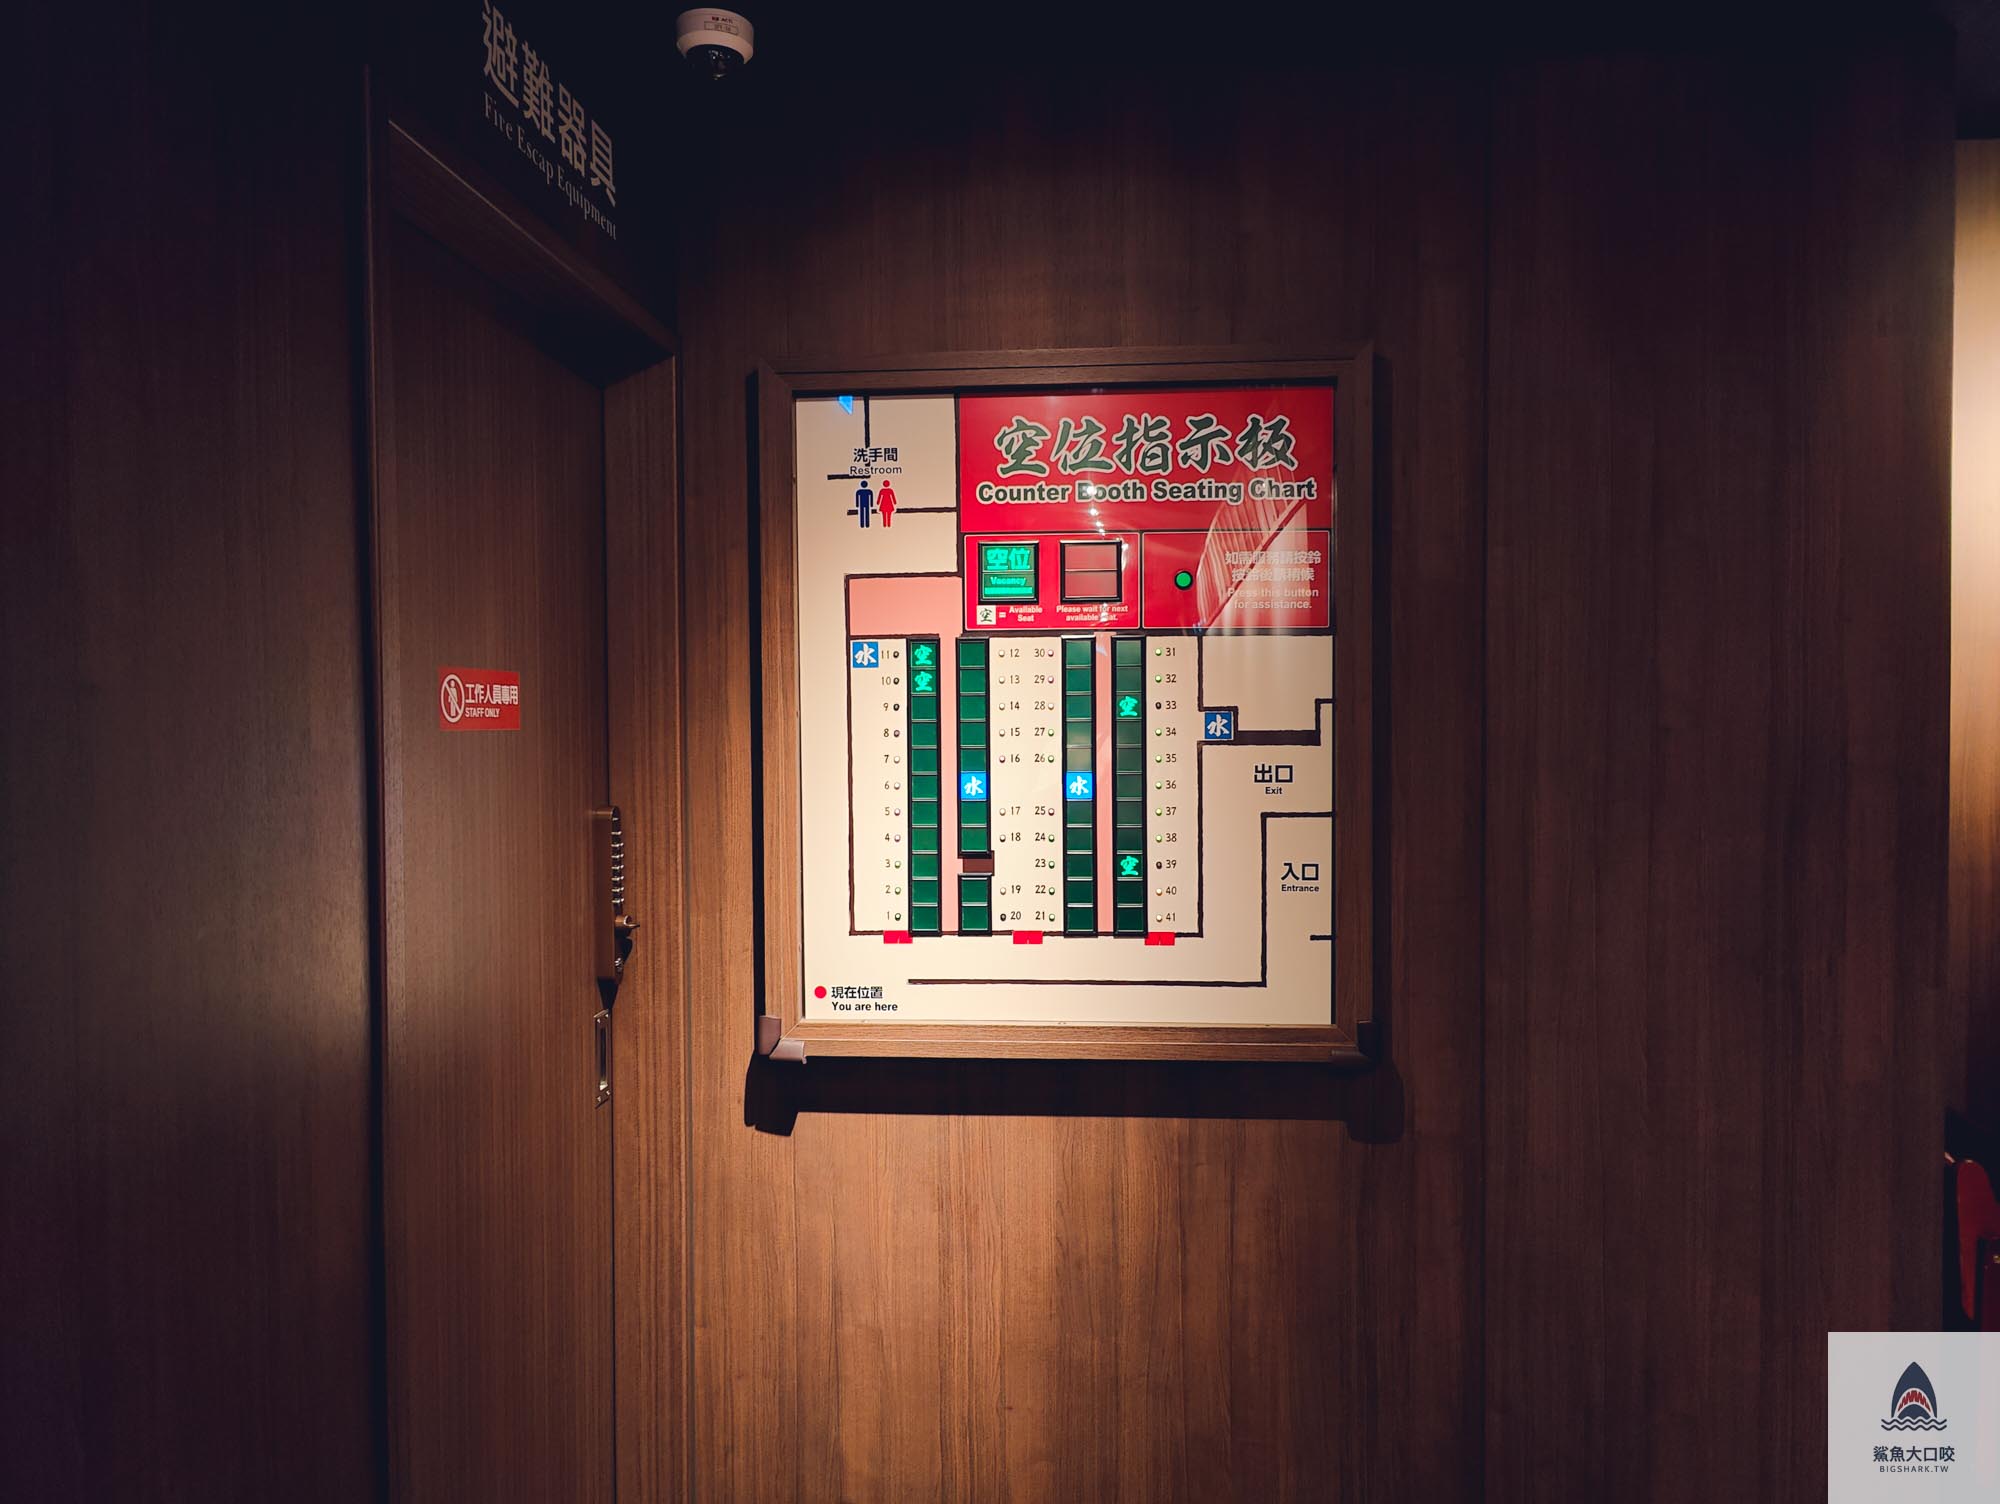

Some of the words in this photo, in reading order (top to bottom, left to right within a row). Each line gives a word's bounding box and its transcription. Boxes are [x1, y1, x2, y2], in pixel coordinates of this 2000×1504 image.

[482, 0, 615, 207] 避難器具
[484, 92, 513, 140] Fire
[518, 125, 554, 185] Escap
[557, 164, 616, 240] Equipment
[994, 413, 1298, 478] 空位指示板
[853, 448, 898, 463] 洗手間
[850, 466, 902, 475] Restroom
[976, 480, 1070, 503] Counter
[1077, 480, 1146, 503] Booth
[1153, 479, 1243, 504] Seating
[1250, 477, 1316, 501] Chart
[986, 547, 1031, 571] 空位
[990, 576, 1026, 586] Vacancy
[1227, 588, 1257, 597] Press
[1262, 588, 1280, 597] this
[1285, 588, 1319, 597] button
[1009, 606, 1043, 614] Available
[1056, 605, 1081, 613] Please
[1082, 605, 1098, 613] wait
[1111, 605, 1128, 613] next
[1234, 600, 1248, 609] for
[1253, 600, 1313, 609] assistance.
[980, 607, 993, 622] 空
[1017, 614, 1034, 622] Seat
[854, 643, 877, 666] 水
[881, 649, 889, 660] 11
[914, 644, 933, 666] 空
[1009, 648, 1020, 658] 12
[1034, 647, 1046, 658] 30
[1165, 646, 1175, 657] 31
[881, 675, 891, 686] 10
[914, 671, 933, 692] 空
[1010, 674, 1020, 685] 13
[1033, 674, 1046, 684] 29
[1165, 673, 1176, 684] 32
[465, 683, 519, 705] 工作人員專用
[882, 702, 888, 712] 9
[1009, 700, 1020, 711] 14
[1034, 700, 1046, 711] 28
[1119, 695, 1138, 717] 空
[1165, 700, 1176, 710] 33
[465, 707, 484, 718] STAFF
[484, 708, 500, 718] ONLY
[1207, 714, 1230, 737] 水
[883, 727, 889, 738] 8
[1010, 726, 1020, 737] 15
[1034, 726, 1046, 737] 27
[1165, 726, 1176, 737] 34
[883, 753, 889, 764] 7
[1010, 753, 1020, 764] 16
[1033, 753, 1046, 763] 26
[1165, 753, 1176, 763] 35
[1254, 763, 1293, 783] 出口
[884, 780, 889, 791] 6
[964, 776, 984, 797] 水
[1070, 776, 1089, 797] 水
[1165, 779, 1176, 790] 36
[1265, 786, 1283, 795] Exit
[884, 806, 890, 817] 5
[1010, 805, 1021, 816] 17
[1034, 805, 1046, 816] 25
[1165, 806, 1176, 816] 37
[884, 832, 890, 843] 4
[1010, 831, 1021, 842] 18
[1034, 831, 1046, 842] 24
[1165, 832, 1177, 843] 38
[885, 858, 890, 869] 3
[1034, 857, 1046, 868] 23
[1119, 855, 1140, 877] 空
[1165, 859, 1176, 869] 39
[1281, 862, 1319, 881] 入口
[884, 884, 891, 895] 2
[1011, 884, 1021, 895] 19
[1034, 884, 1046, 895] 22
[1165, 885, 1177, 896] 40
[1281, 884, 1320, 892] Entrance
[886, 910, 889, 921] 1
[1009, 910, 1021, 921] 20
[1034, 910, 1046, 921] 21
[1165, 912, 1175, 922] 41
[831, 986, 883, 999] 現在位置
[831, 1001, 852, 1011] You
[854, 1003, 872, 1011] are
[874, 1001, 898, 1011] here
